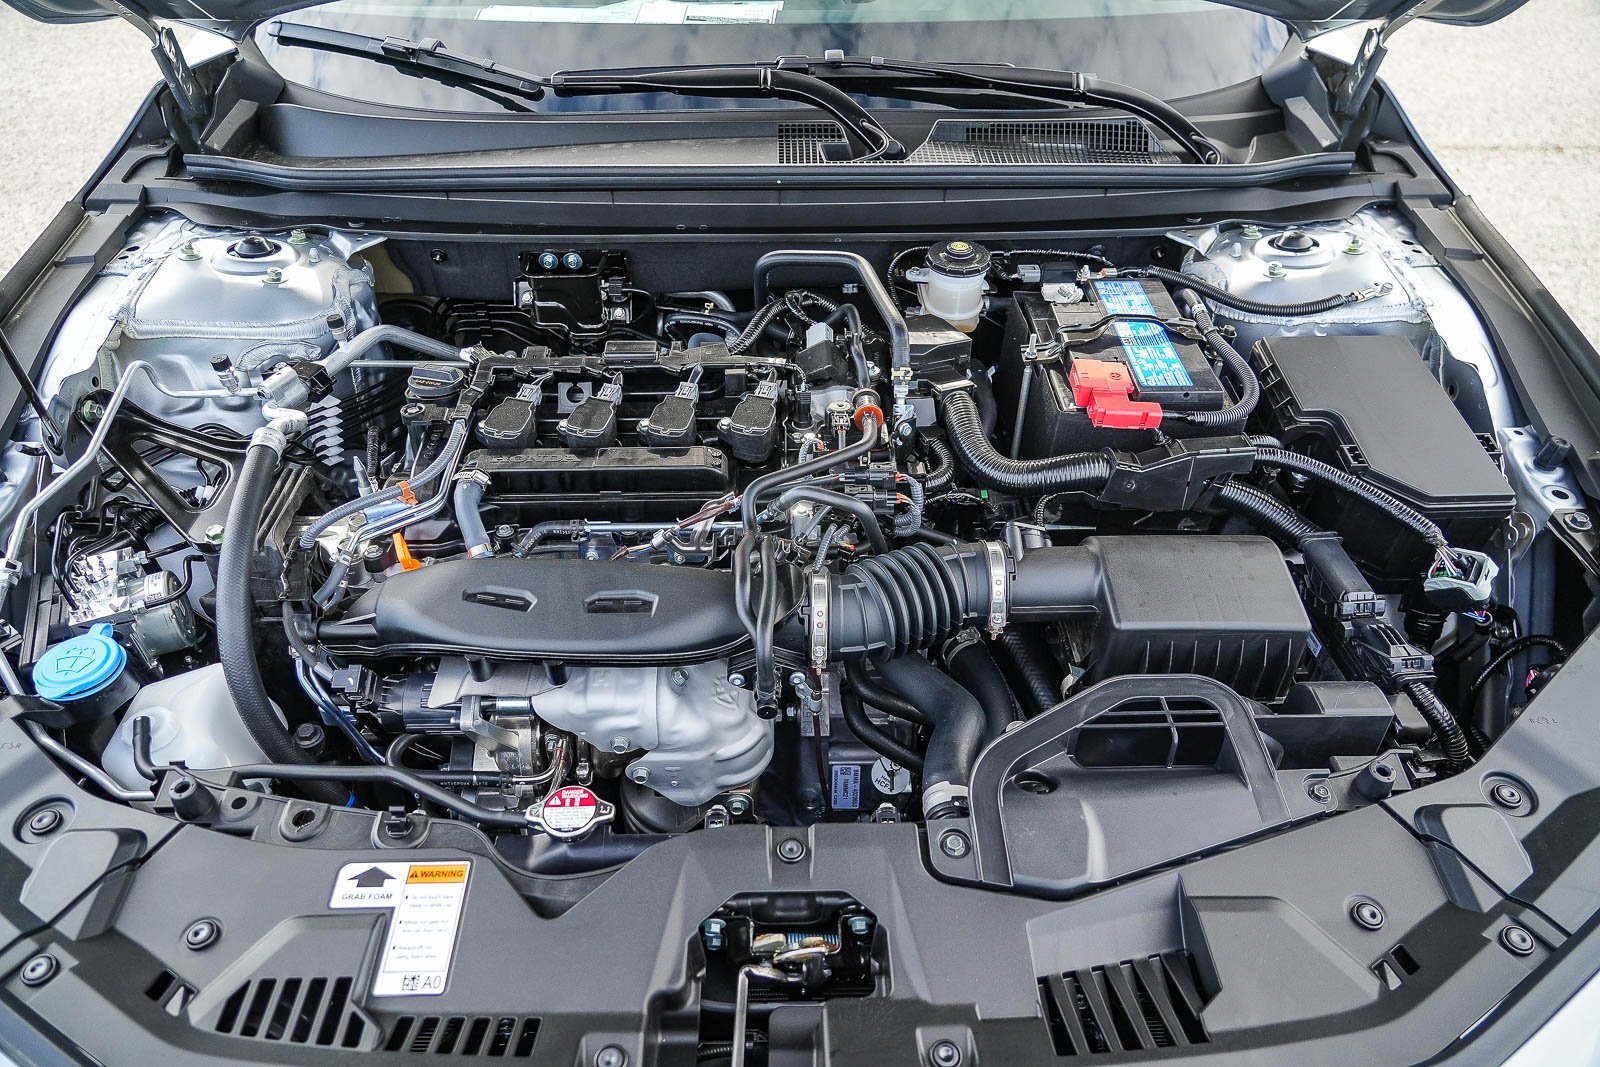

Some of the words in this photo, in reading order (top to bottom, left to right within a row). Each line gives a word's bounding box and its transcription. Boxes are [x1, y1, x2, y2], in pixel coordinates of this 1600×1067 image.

[490, 454, 581, 463] HONDA
[421, 870, 463, 878] WARNING
[422, 976, 441, 989] A0
